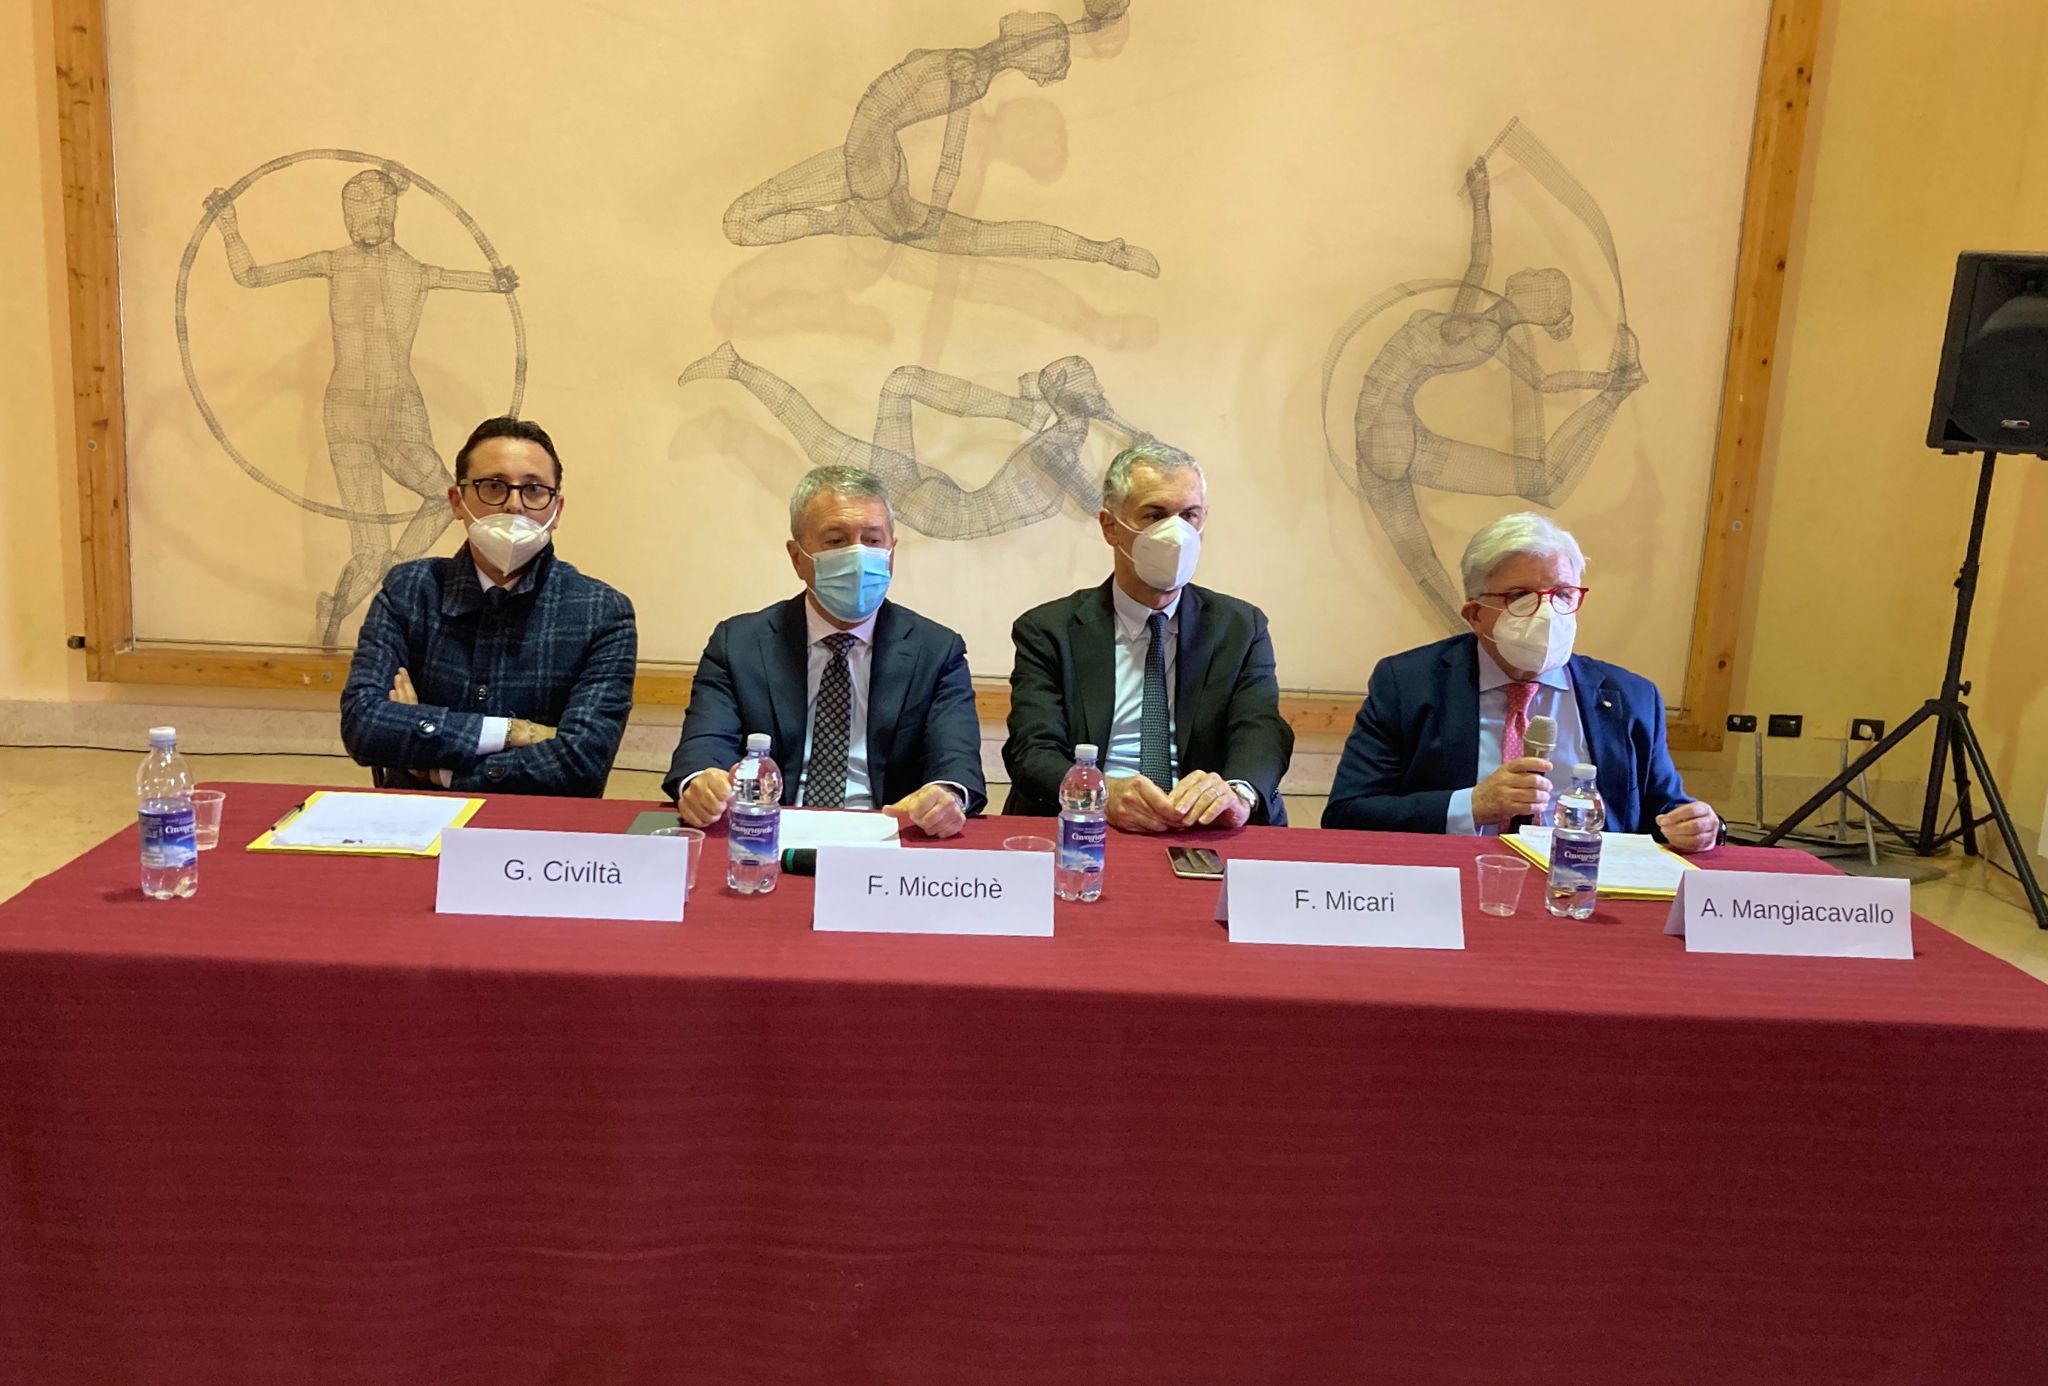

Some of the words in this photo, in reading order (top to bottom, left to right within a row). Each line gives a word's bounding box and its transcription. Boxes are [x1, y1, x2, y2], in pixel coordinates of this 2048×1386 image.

[504, 858, 532, 881] G.
[543, 860, 622, 885] Civiltà
[868, 874, 889, 896] F.
[899, 876, 1003, 899] Miccichè
[1295, 889, 1316, 910] F.
[1326, 890, 1394, 913] Micari
[1700, 897, 1724, 918] A.
[1732, 898, 1894, 926] Mangiacavallo
